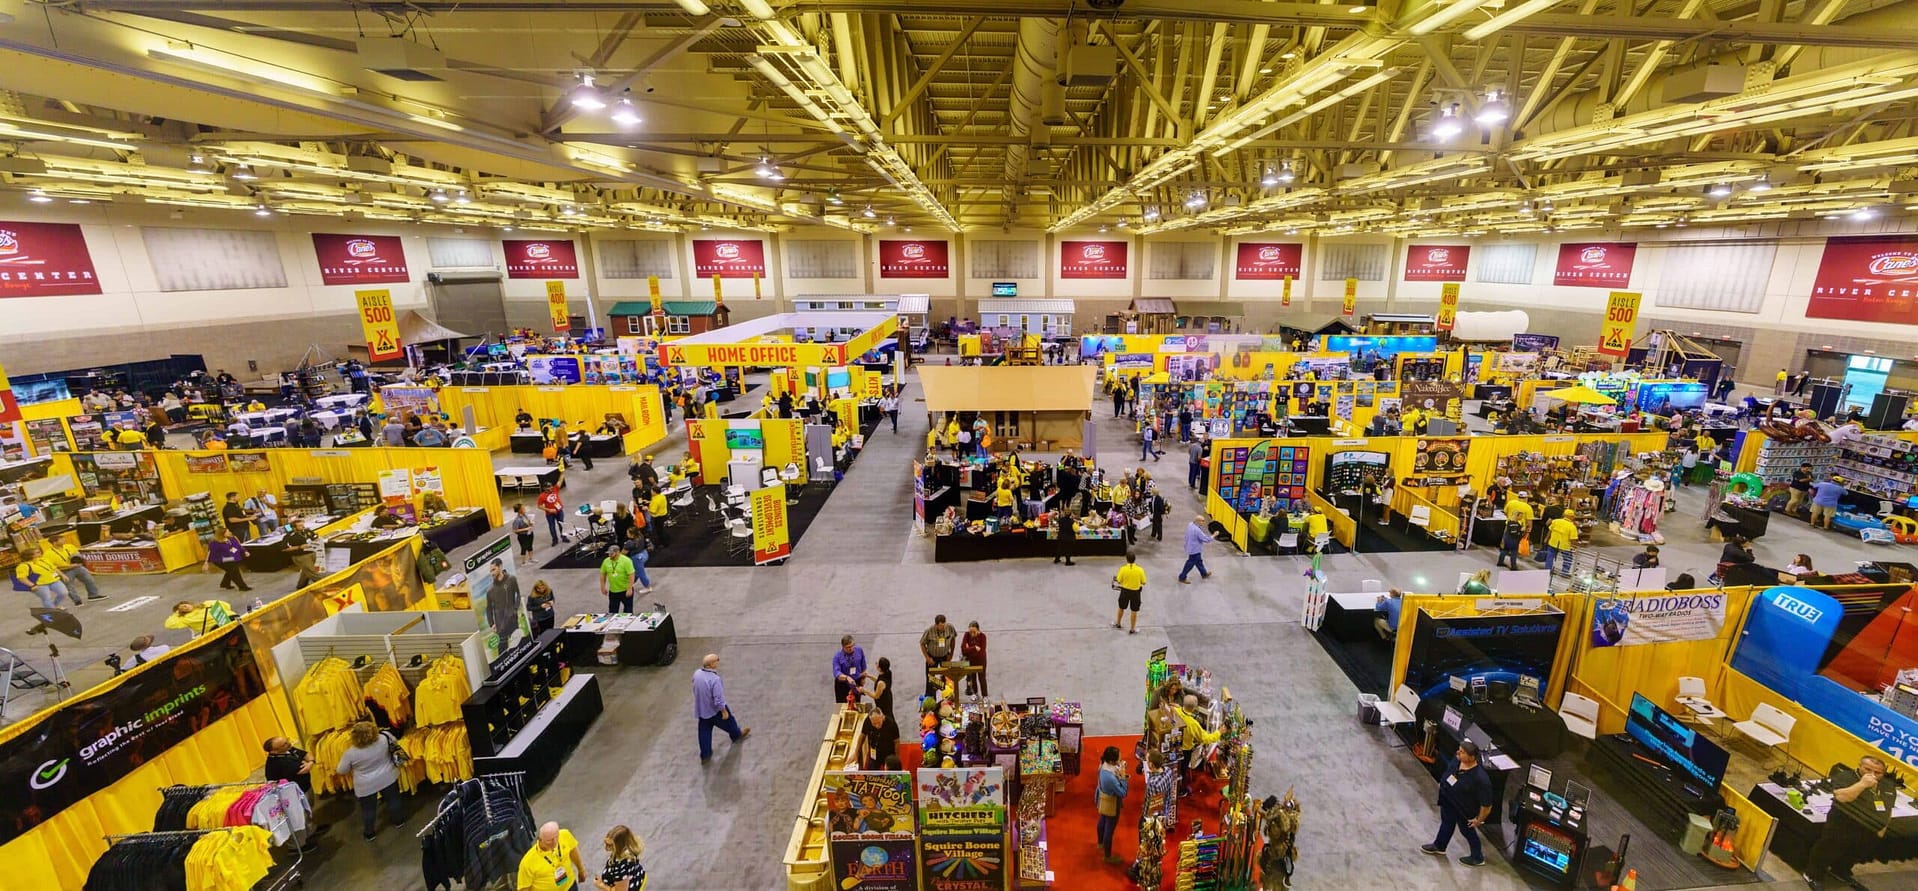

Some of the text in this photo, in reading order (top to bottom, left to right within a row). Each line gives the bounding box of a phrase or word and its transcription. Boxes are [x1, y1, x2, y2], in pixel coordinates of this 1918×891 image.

[1, 271, 93, 281] CENTER
[324, 266, 407, 275] RIVER CENTER
[549, 286, 562, 294] AISLE
[1816, 287, 1873, 296] RIVER
[362, 296, 388, 307] AISLE
[550, 293, 565, 305] 400
[1442, 294, 1456, 306] 400
[1611, 297, 1635, 308] AISLE
[363, 306, 391, 324] 500
[1608, 307, 1634, 323] 500
[377, 344, 396, 352] KOA
[707, 346, 797, 363] HOME OFFICE
[868, 375, 880, 397] KITS
[755, 497, 765, 539] CONSULTANTS
[763, 494, 775, 537] DEVELOPMENT
[773, 499, 783, 529] BUSINESS
[83, 553, 141, 561] MINI DONUTS
[1620, 595, 1722, 613] RADIOBOSS
[1639, 610, 1692, 620] TWO-WAY RADIOS
[1449, 624, 1557, 637] Assisted TV Solutions
[79, 683, 206, 760] graphic imprints
[1869, 716, 1894, 733] DO
[1867, 724, 1890, 738] HAVE
[1891, 735, 1908, 748] THE
[851, 780, 907, 805] TATTOOS
[928, 811, 993, 820] HITCHERS
[973, 828, 1001, 836] Village
[924, 842, 1001, 852] Squire Boone
[943, 850, 984, 860] Village
[847, 861, 906, 876] EARTH
[936, 880, 989, 891] CRYSTAL
